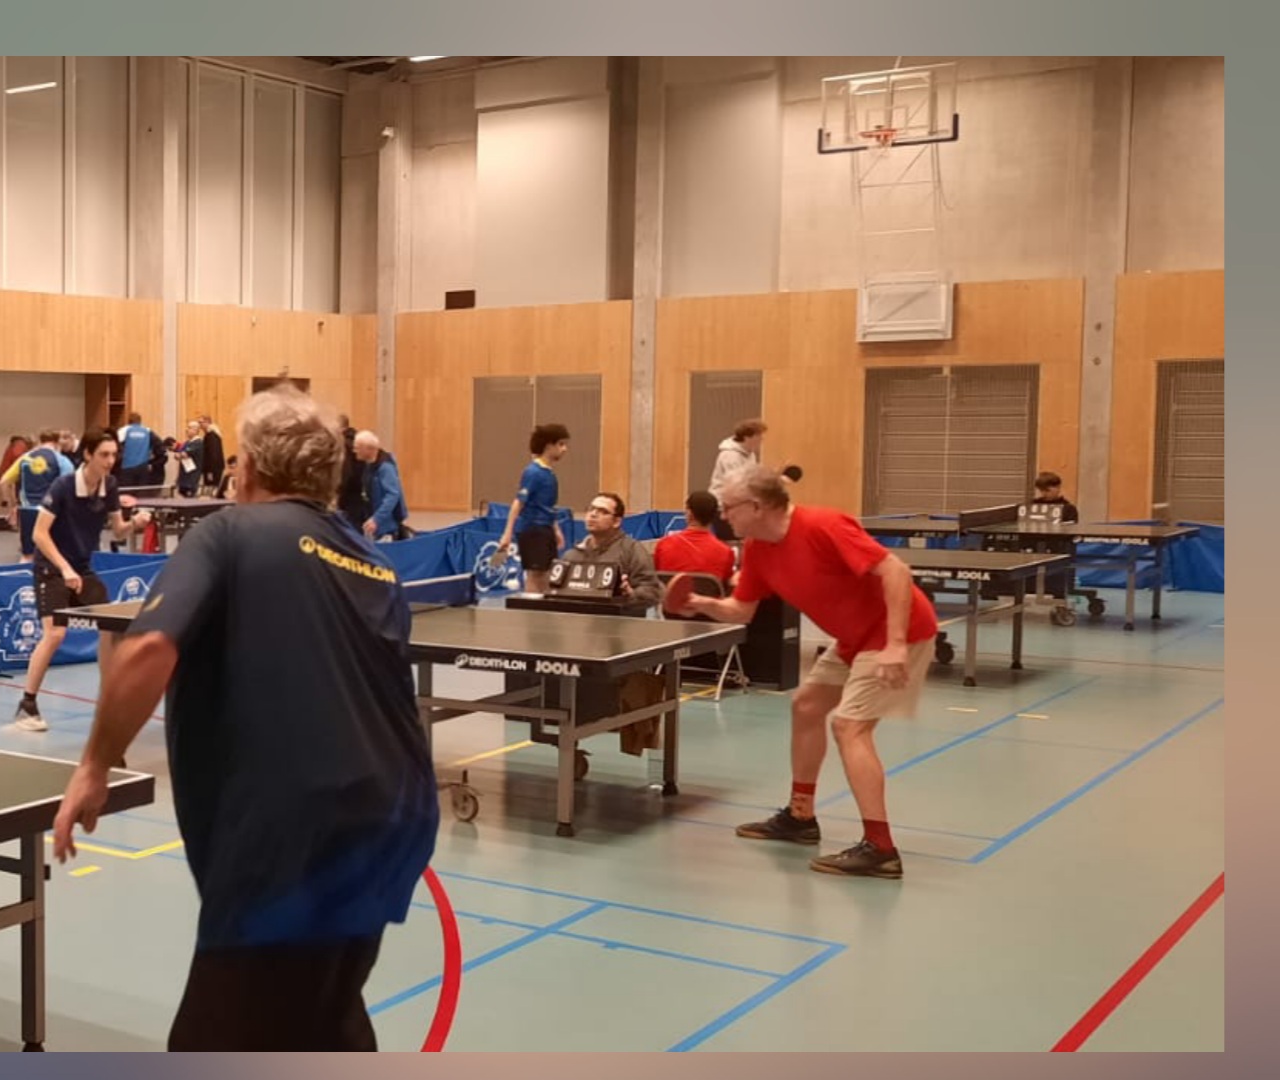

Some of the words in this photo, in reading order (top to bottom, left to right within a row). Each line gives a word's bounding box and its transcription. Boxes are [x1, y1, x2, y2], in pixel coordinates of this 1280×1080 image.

[317, 544, 396, 584] DECATHLON
[550, 564, 563, 581] 9
[602, 567, 613, 586] 9
[957, 571, 990, 580] JOOLA
[67, 617, 98, 631] JOOLA
[469, 656, 526, 671] DECATHLON
[535, 660, 581, 677] JOOLA
